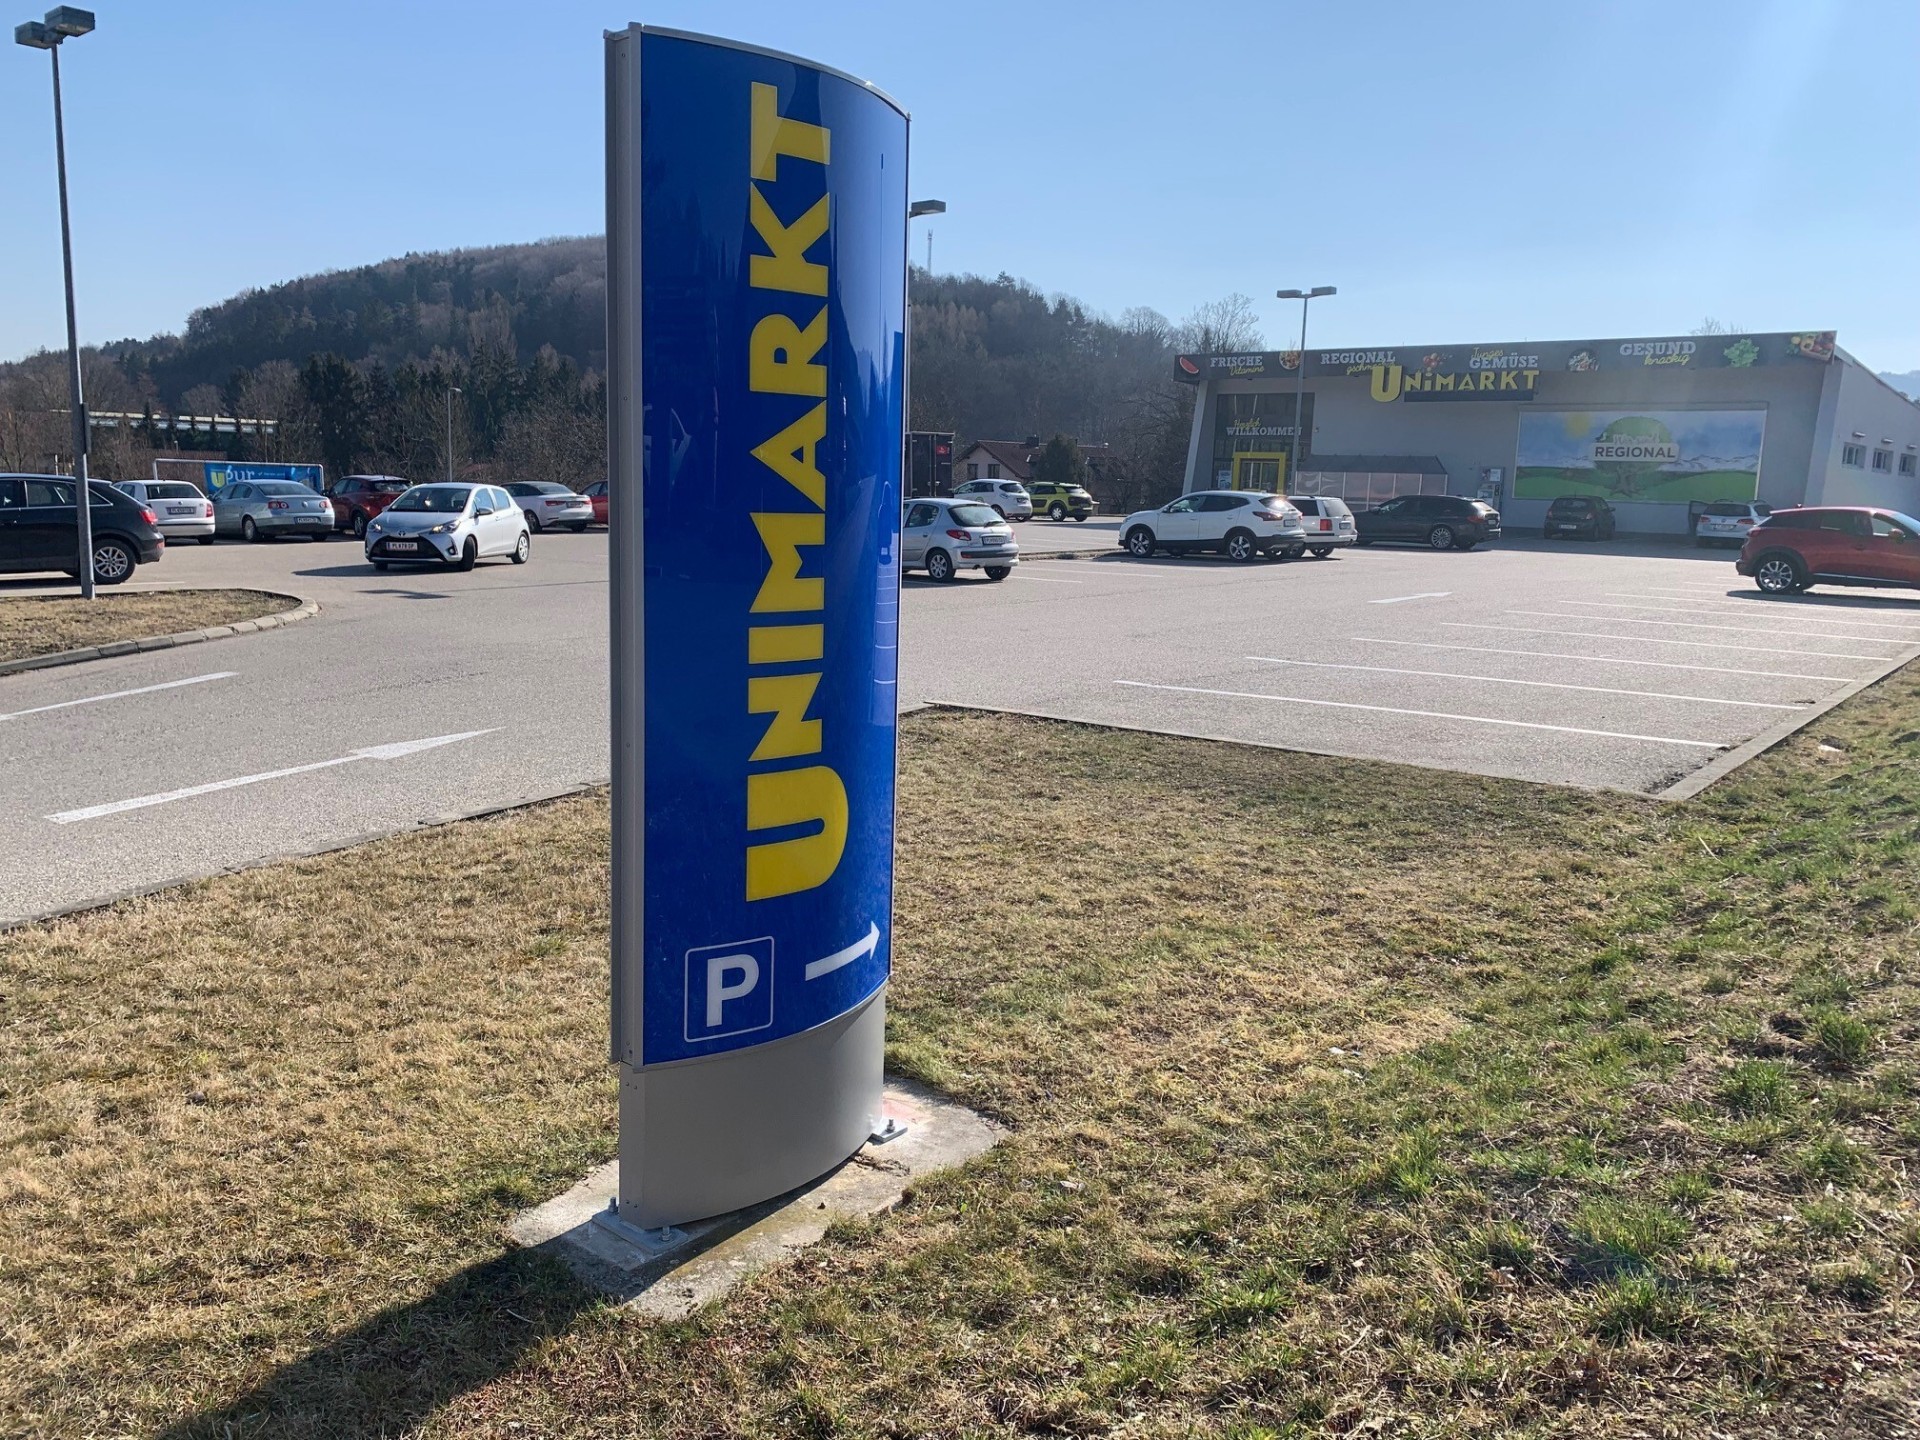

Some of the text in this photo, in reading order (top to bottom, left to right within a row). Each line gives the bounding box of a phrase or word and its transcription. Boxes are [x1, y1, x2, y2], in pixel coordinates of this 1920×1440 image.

[1620, 341, 1696, 355] GESUND
[1210, 356, 1263, 367] FRISCHE
[1321, 351, 1396, 364] REGIONAL
[1469, 352, 1539, 369] GEMÜSE
[1595, 446, 1676, 458] REGIONAL
[746, 81, 849, 902] UNIMARKT
[706, 953, 760, 1027] P
